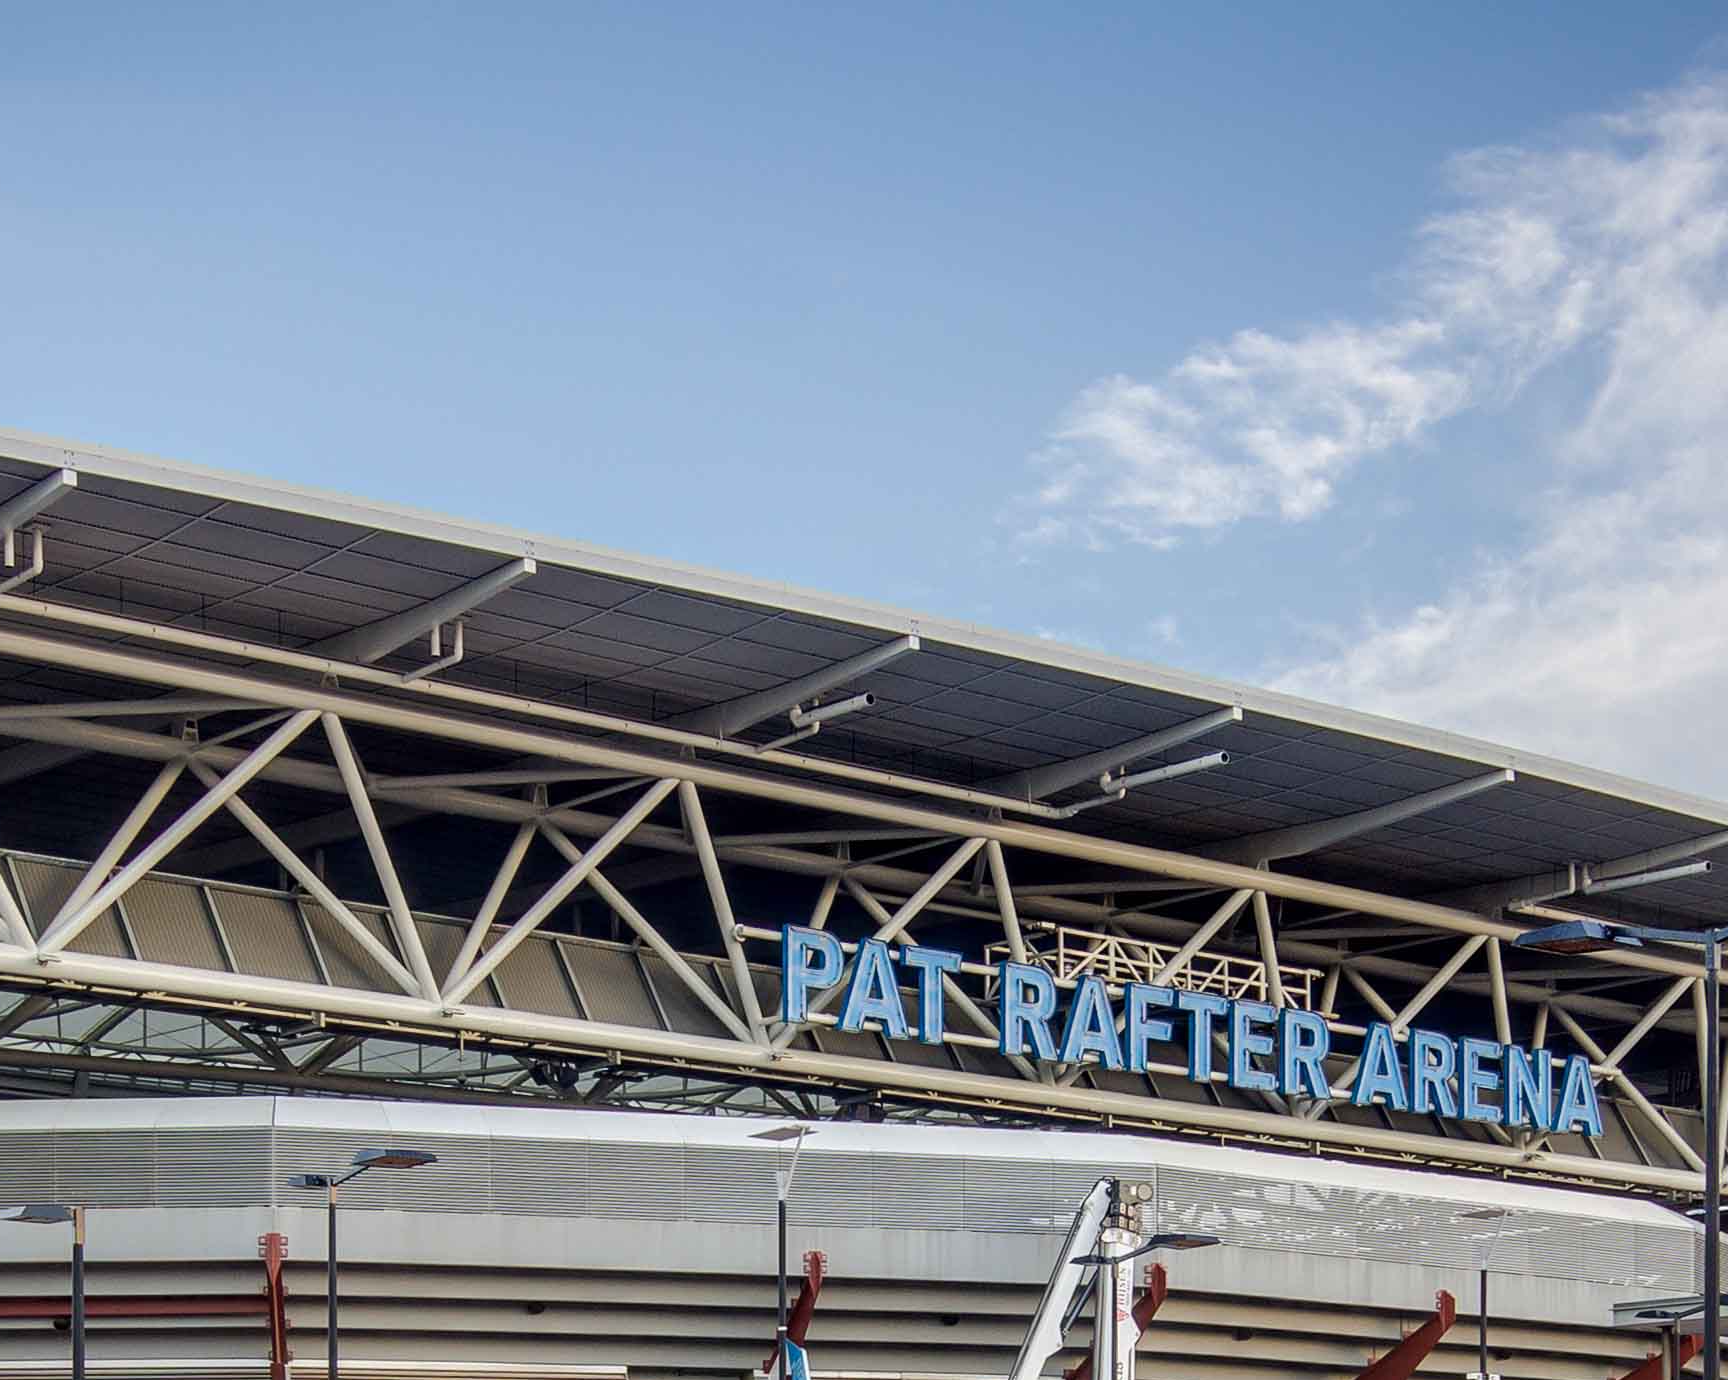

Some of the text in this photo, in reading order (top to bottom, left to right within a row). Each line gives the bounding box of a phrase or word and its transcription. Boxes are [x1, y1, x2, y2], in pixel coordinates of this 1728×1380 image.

[782, 922, 1604, 1137] PAT RAFTER ARENA
